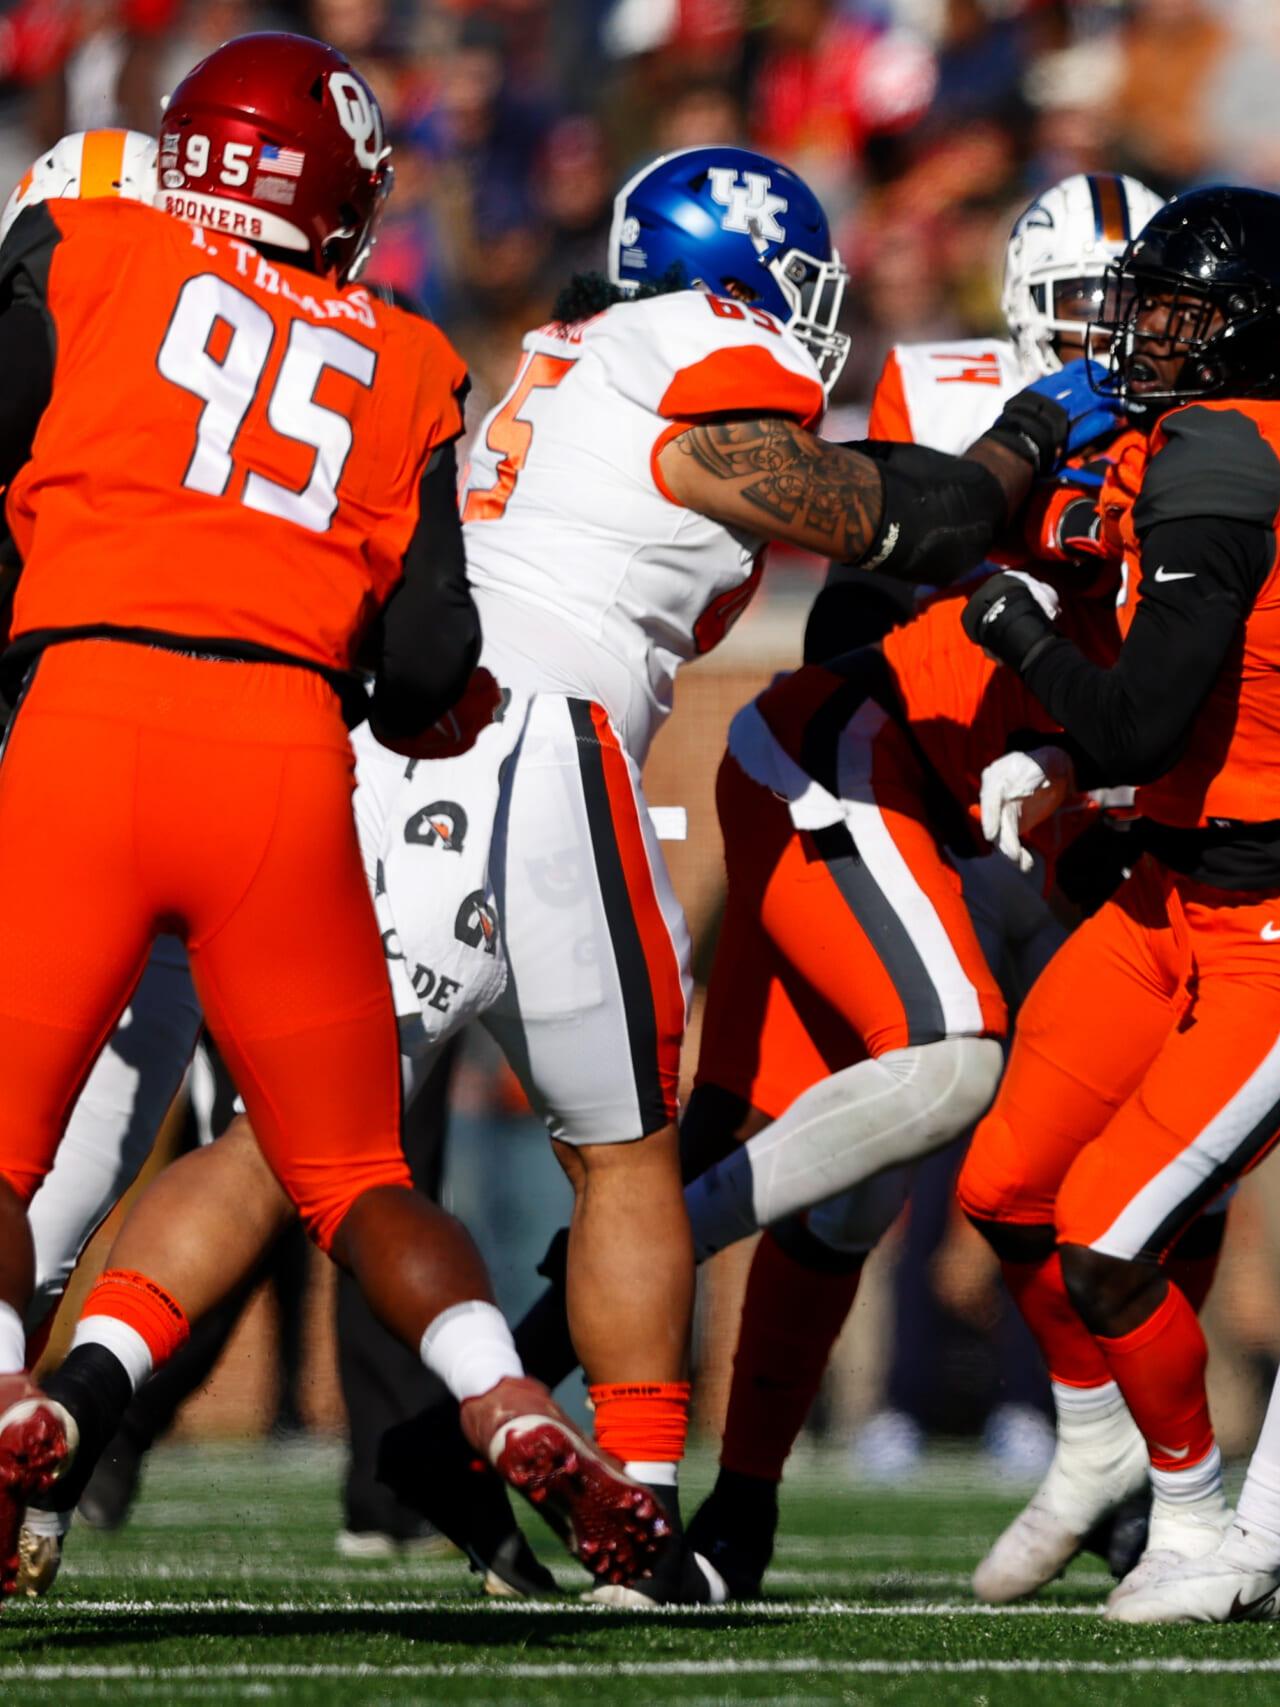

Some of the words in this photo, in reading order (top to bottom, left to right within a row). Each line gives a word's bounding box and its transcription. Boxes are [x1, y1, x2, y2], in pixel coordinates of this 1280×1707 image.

[184, 134, 253, 187] 95
[165, 196, 263, 238] SOONERS
[707, 166, 788, 243] UK
[157, 272, 378, 534] 95
